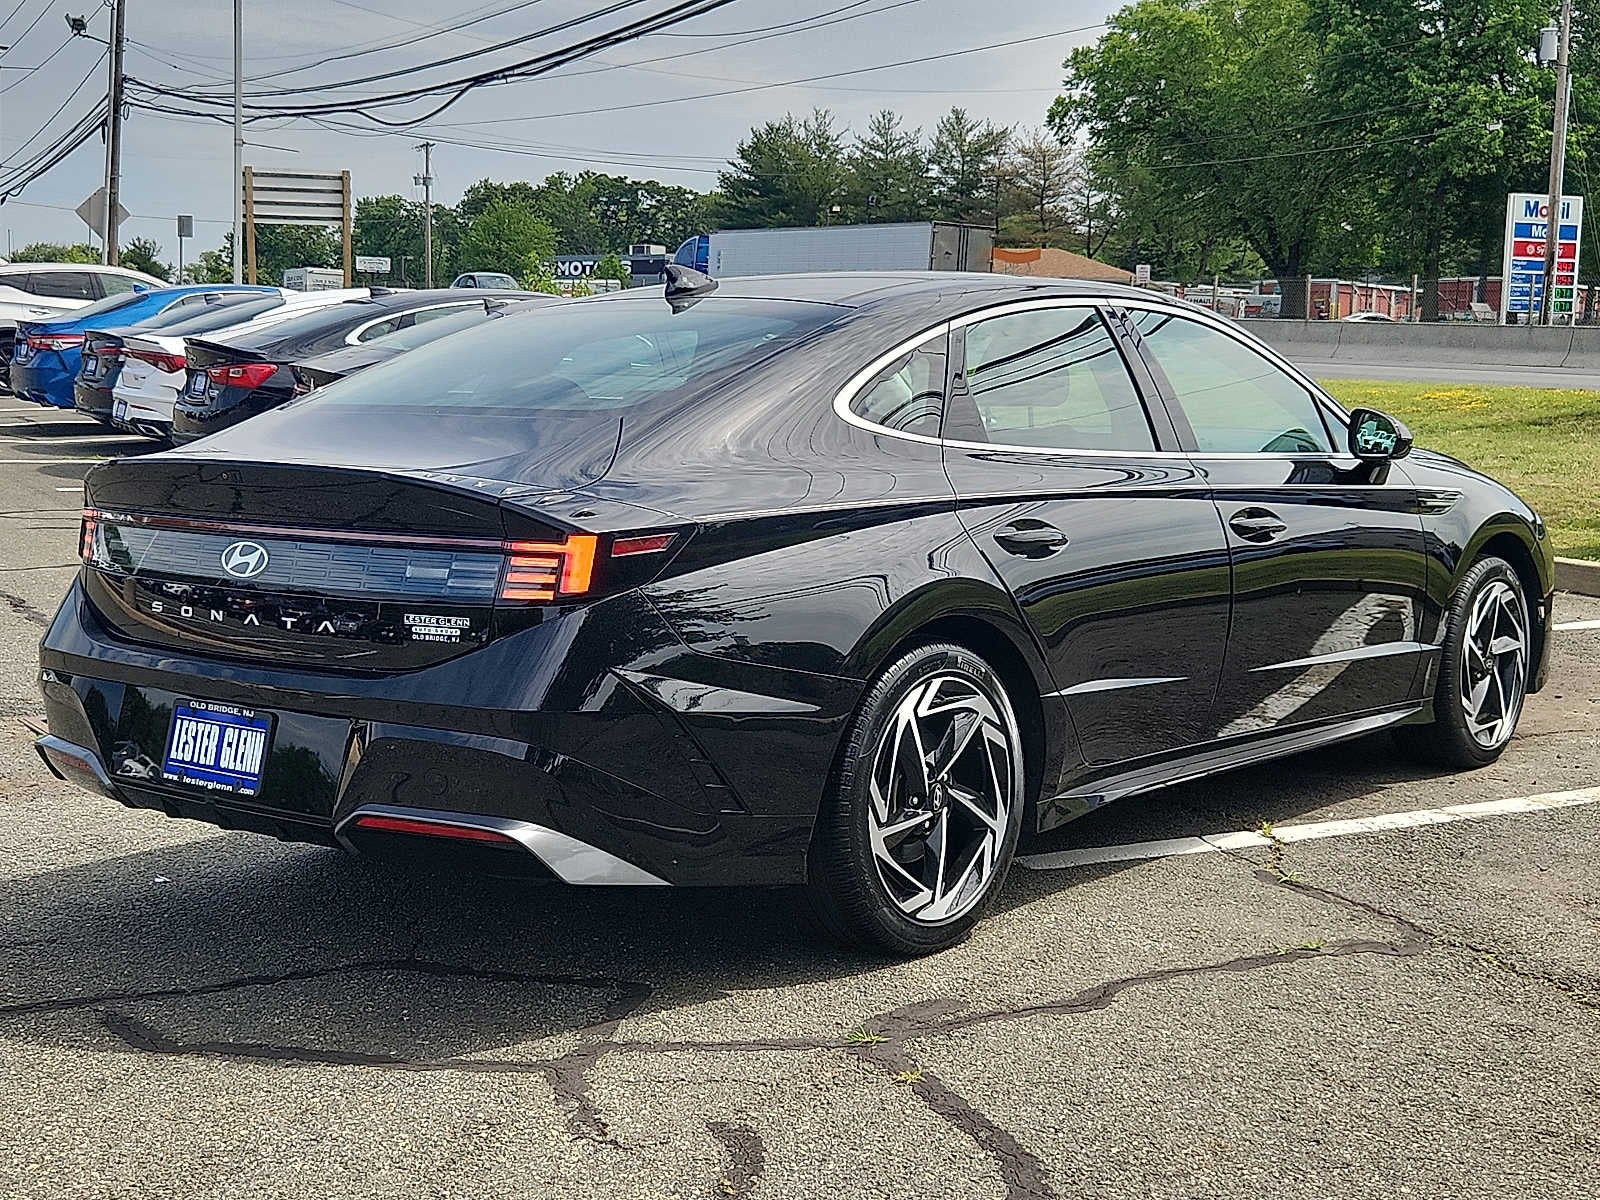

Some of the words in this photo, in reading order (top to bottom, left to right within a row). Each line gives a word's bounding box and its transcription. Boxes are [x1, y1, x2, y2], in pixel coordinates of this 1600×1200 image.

[1524, 200, 1571, 219] Moil
[557, 260, 632, 276] MOTS
[152, 600, 335, 633] SONATA
[404, 615, 437, 625] LESTER
[438, 618, 470, 627] GLENN
[190, 701, 207, 709] OLD
[208, 704, 241, 716] BRIDGE,
[243, 709, 254, 717] NJ
[170, 719, 220, 766] LESTER
[220, 727, 266, 775] GLENN
[163, 772, 180, 781] www.
[183, 776, 233, 792] lesterglenn
[238, 787, 254, 795] .com
